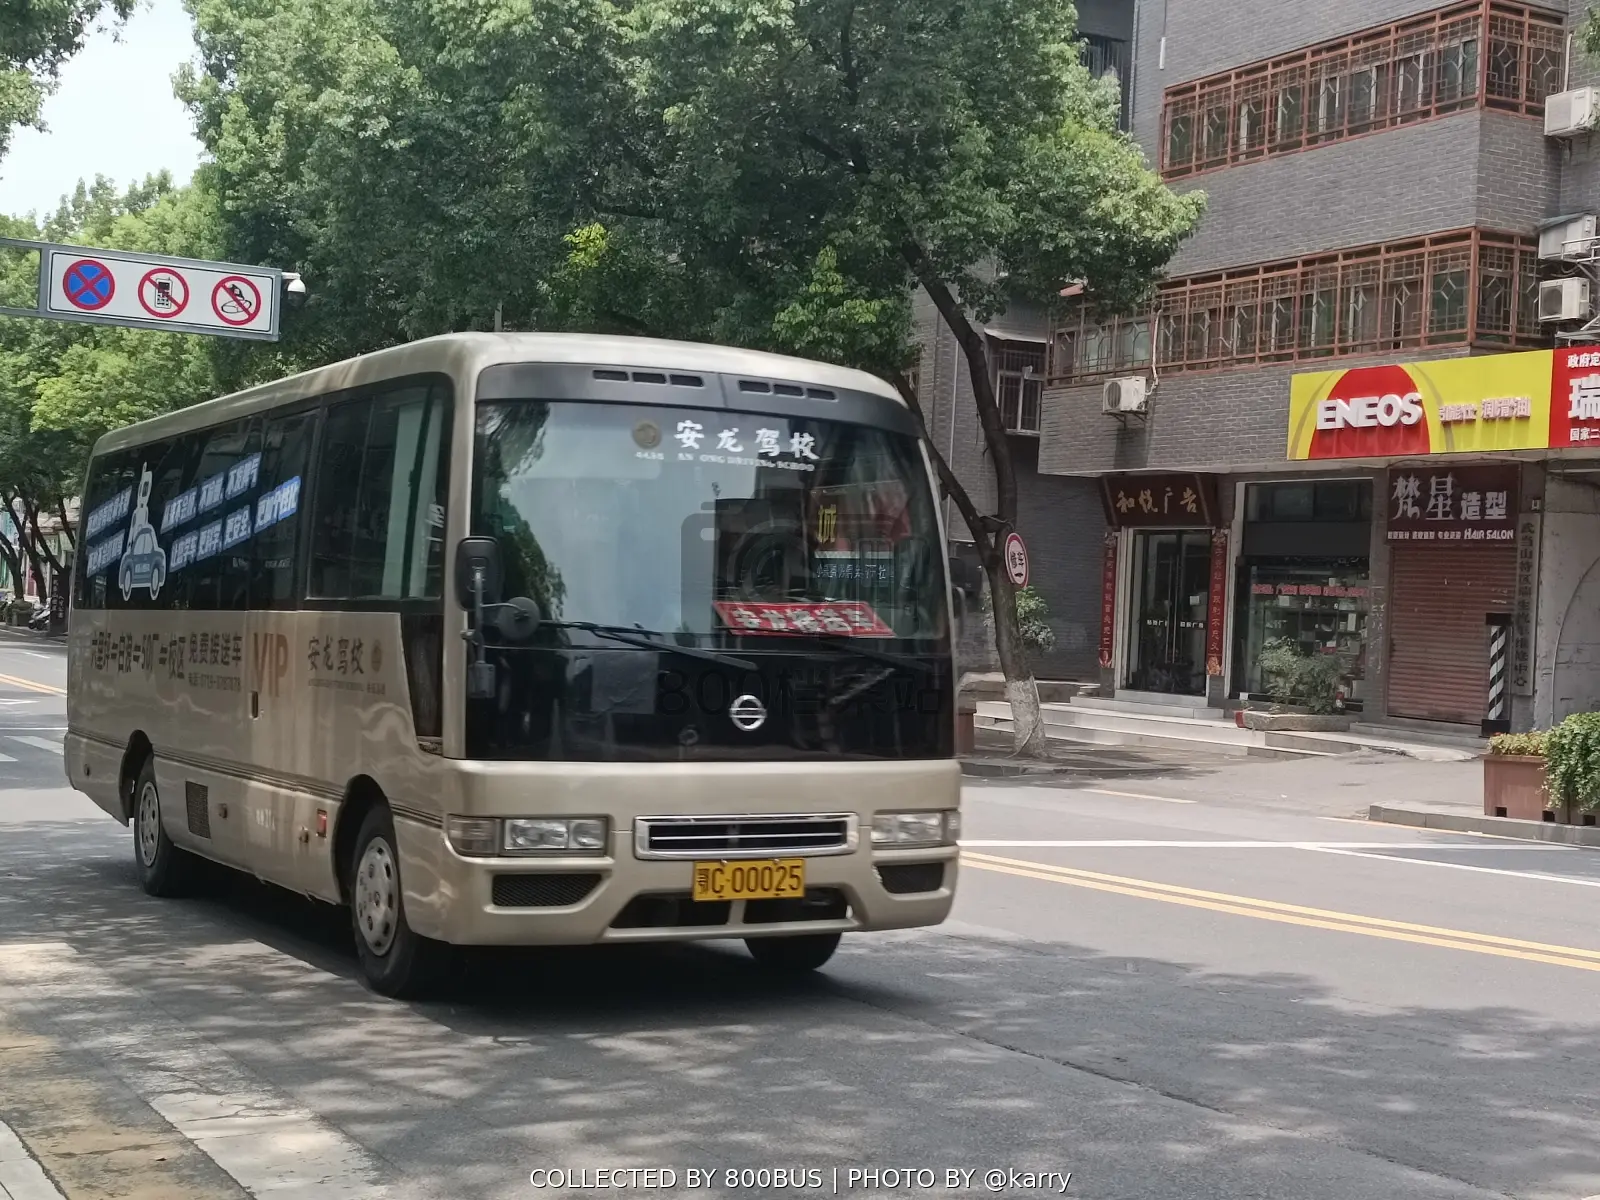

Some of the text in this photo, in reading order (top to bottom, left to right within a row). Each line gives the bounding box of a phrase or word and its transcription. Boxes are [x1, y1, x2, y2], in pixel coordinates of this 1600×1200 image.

[1317, 392, 1423, 430] ENEOS
[1481, 397, 1531, 420] 润滑油
[674, 420, 820, 460] 安龙驾校
[1391, 472, 1507, 520] 梵星造型
[1464, 527, 1485, 540] HAIR
[1486, 529, 1514, 540] SALON
[253, 632, 289, 698] VIP
[308, 635, 365, 675] 安龙驾校
